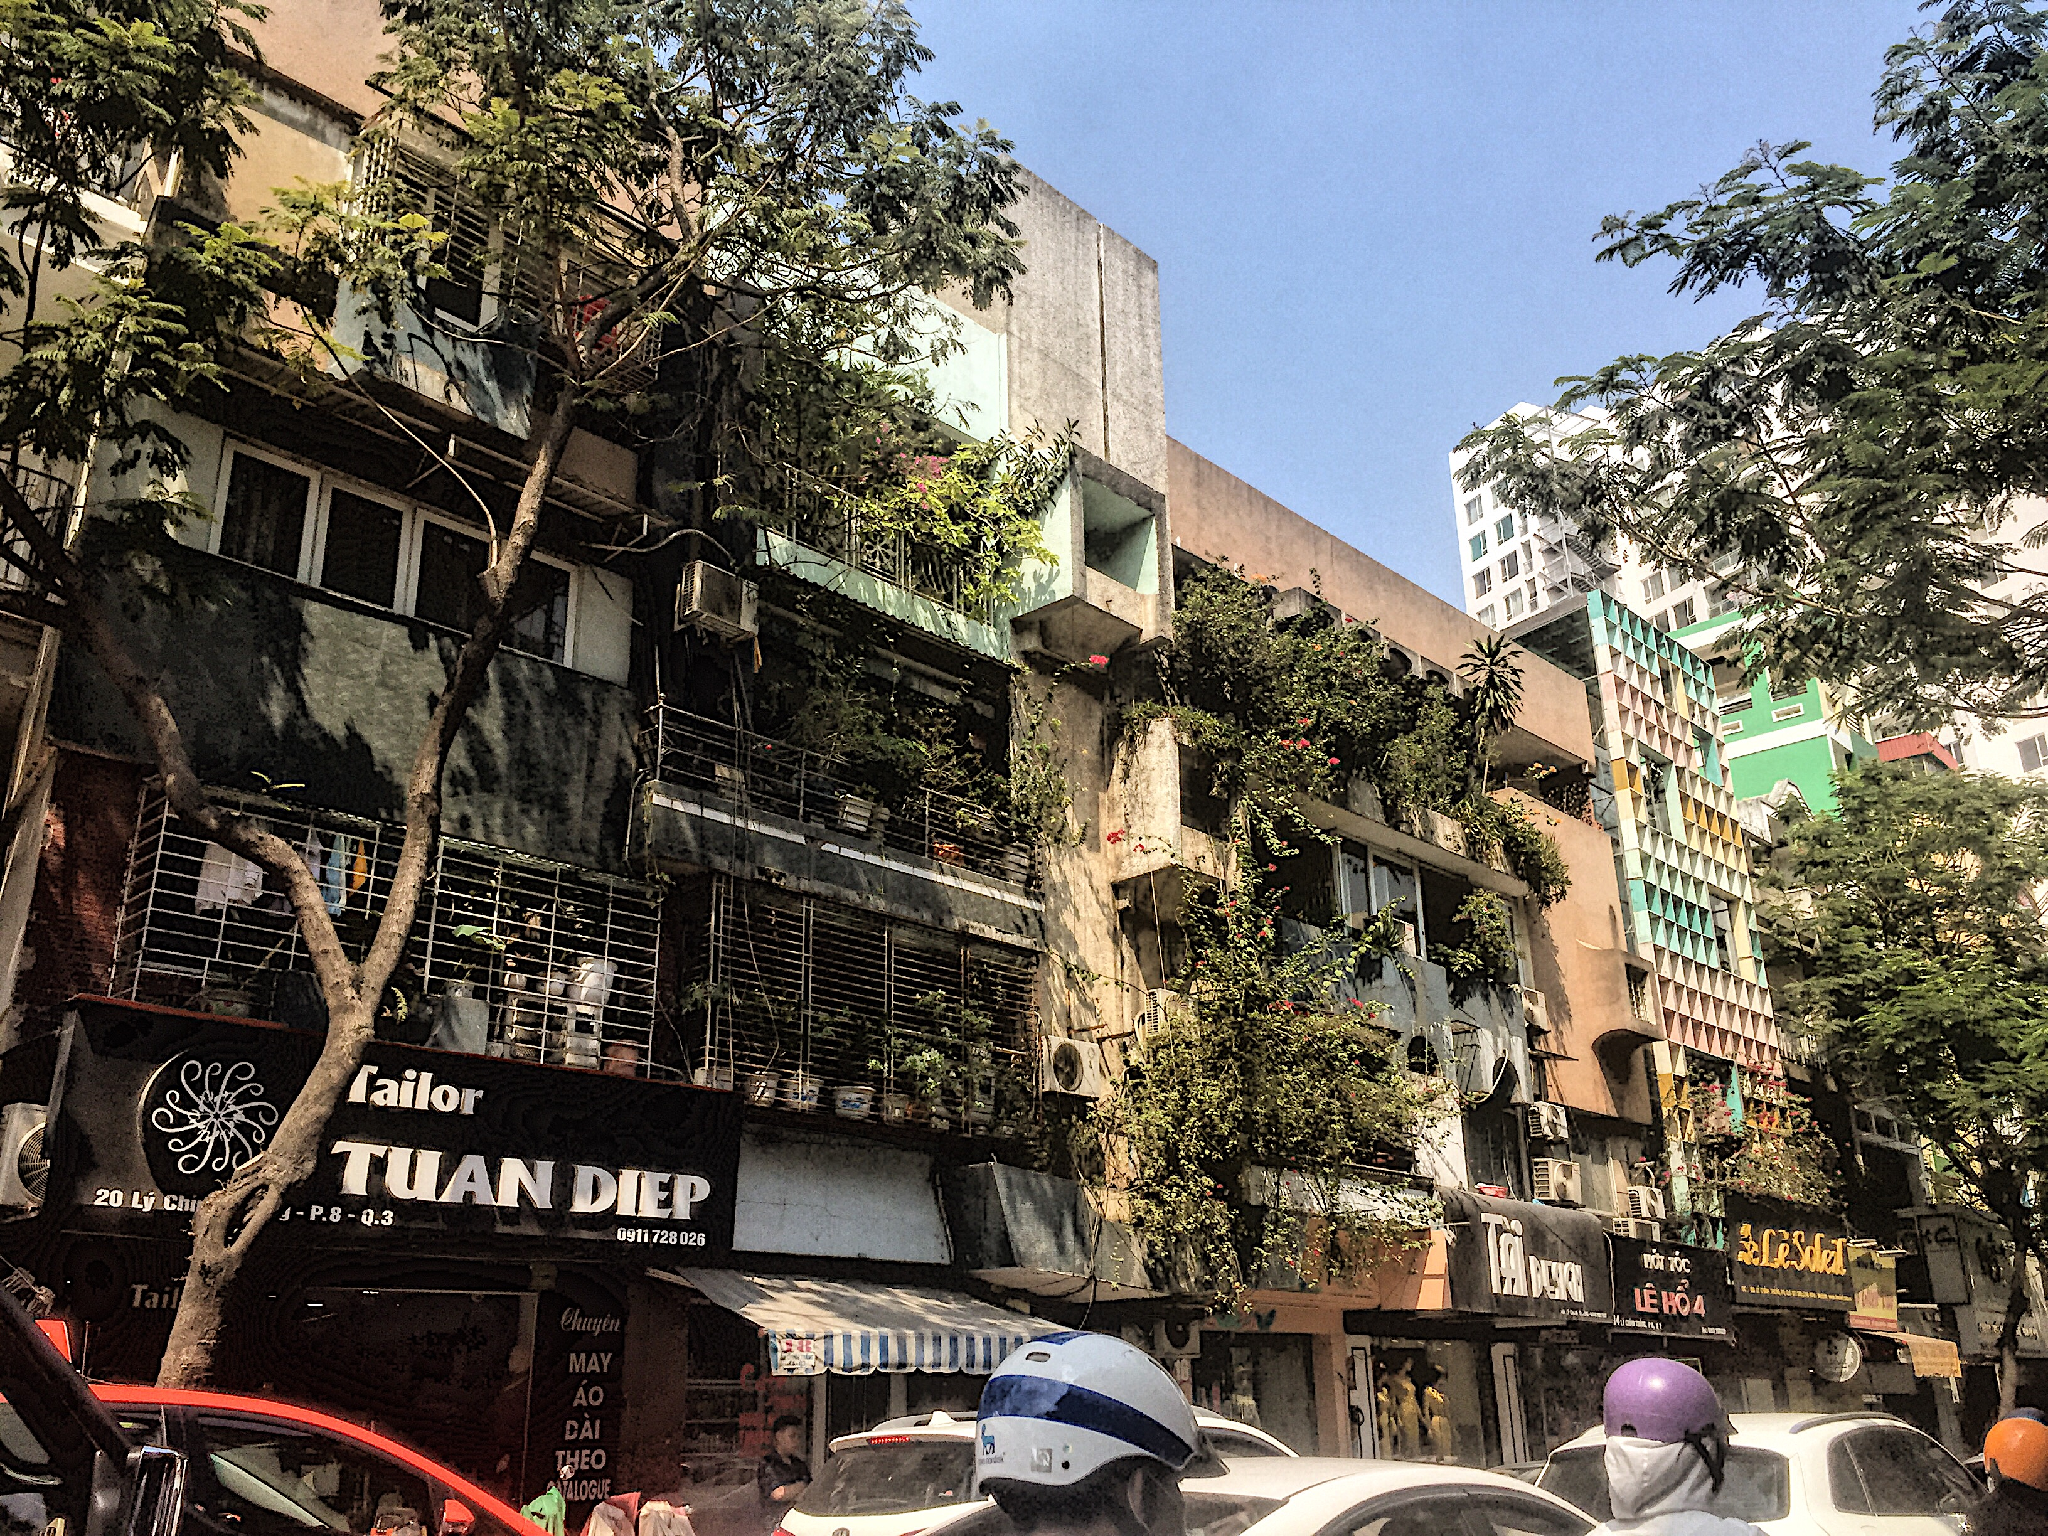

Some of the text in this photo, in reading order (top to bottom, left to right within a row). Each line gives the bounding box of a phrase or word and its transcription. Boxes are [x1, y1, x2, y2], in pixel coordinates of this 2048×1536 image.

[347, 1065, 484, 1115] Tailor
[332, 1141, 711, 1220] TUAN DIEP
[94, 1188, 124, 1208] 20
[131, 1191, 156, 1213] Lý
[1634, 1282, 1660, 1314] LÊ
[568, 1352, 613, 1374] MAY
[572, 1379, 605, 1407] ÁO
[564, 1412, 601, 1440] DÀI
[555, 1448, 607, 1472] THEO
